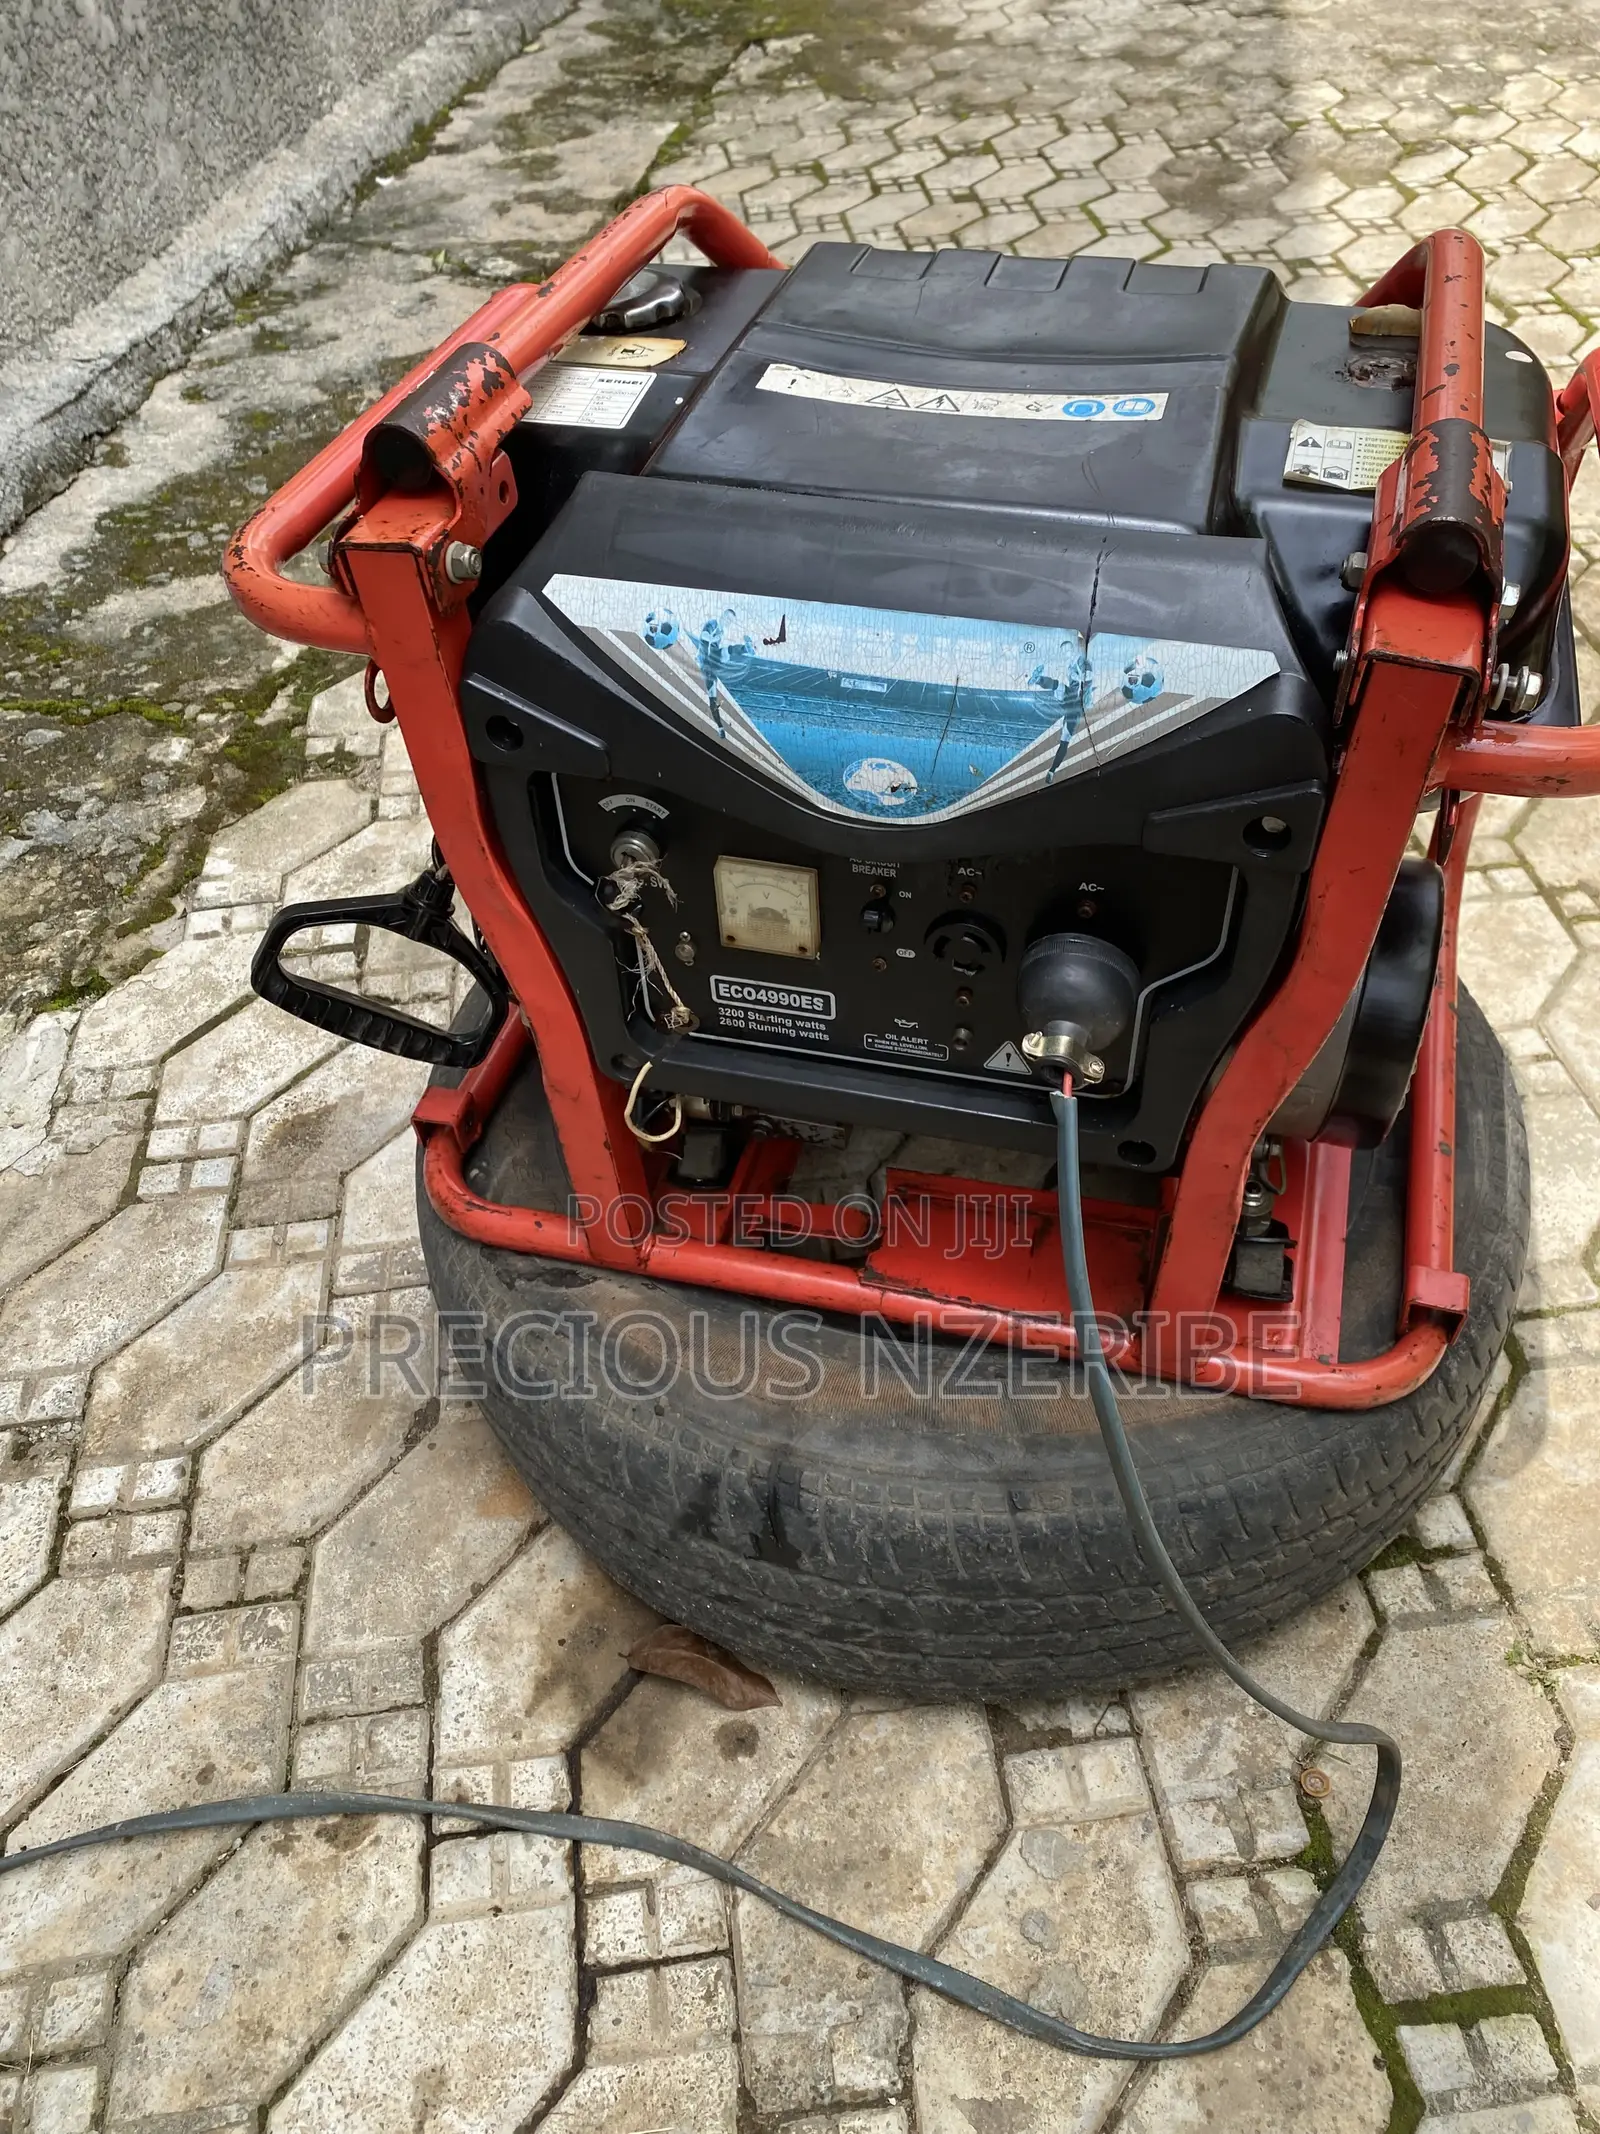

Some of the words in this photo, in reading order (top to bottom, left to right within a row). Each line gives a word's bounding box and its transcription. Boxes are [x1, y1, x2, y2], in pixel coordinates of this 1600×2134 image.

[645, 801, 666, 816] START
[851, 863, 897, 878] BREAKER
[898, 890, 912, 899] ON
[718, 982, 824, 1011] ECO4990ES
[718, 1007, 745, 1018] 3200
[747, 1011, 792, 1026] Starting
[795, 1018, 826, 1031] watts
[748, 1021, 796, 1037] Running
[799, 1029, 830, 1041] watts
[885, 1033, 899, 1041] OIL
[901, 1036, 929, 1045] ALERT
